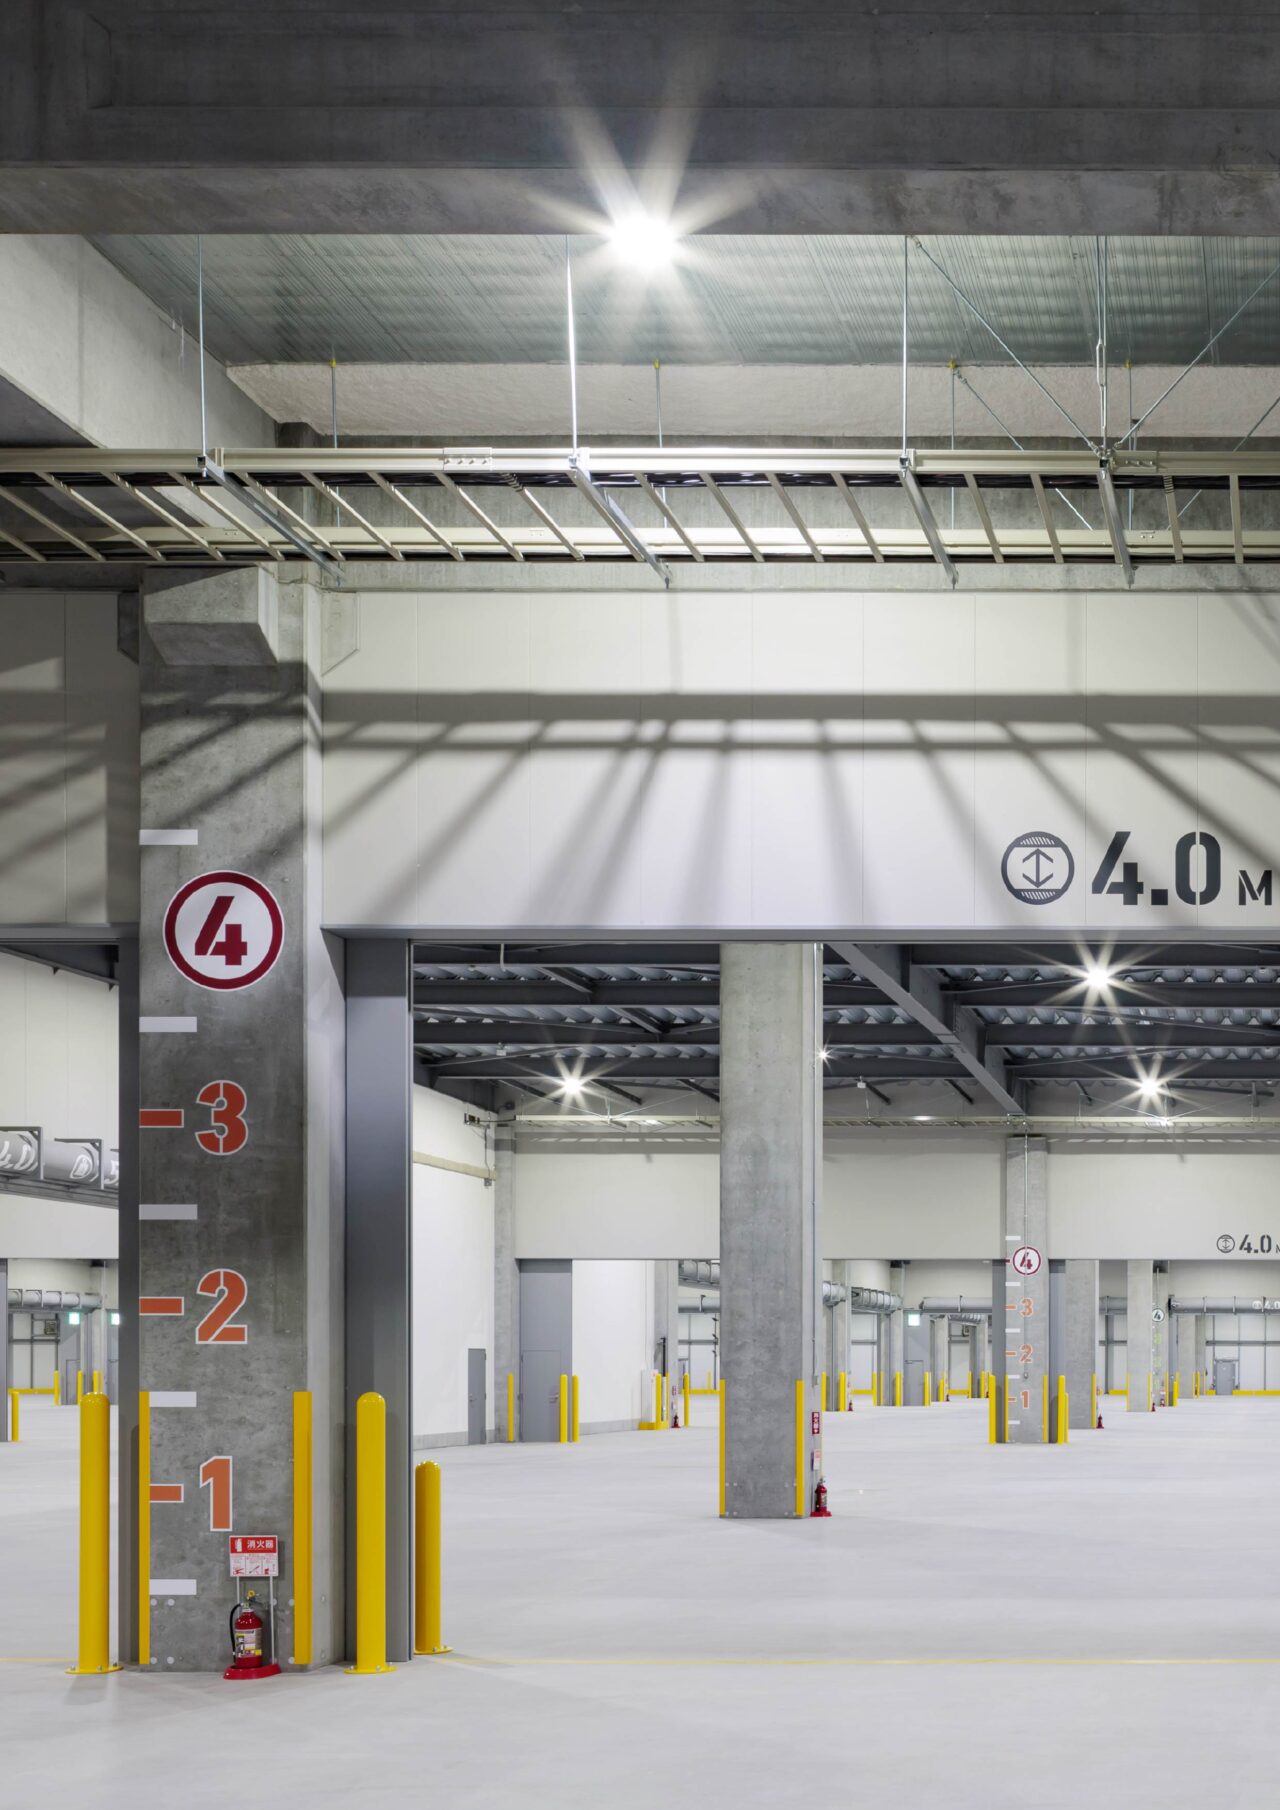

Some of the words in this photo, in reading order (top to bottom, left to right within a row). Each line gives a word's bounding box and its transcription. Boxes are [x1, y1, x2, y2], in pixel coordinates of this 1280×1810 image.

[1091, 831, 1222, 906] 4.0
[1239, 869, 1273, 906] M
[194, 895, 248, 965] 4
[195, 1079, 248, 1155] 3
[1239, 1234, 1272, 1254] 4.0
[1019, 1251, 1033, 1270] 4
[195, 1268, 248, 1344] 2
[1020, 1298, 1034, 1317] 3
[1019, 1343, 1034, 1363] 2
[1020, 1390, 1030, 1408] 1
[199, 1455, 233, 1532] 1
[247, 1540, 274, 1549] 消火器
